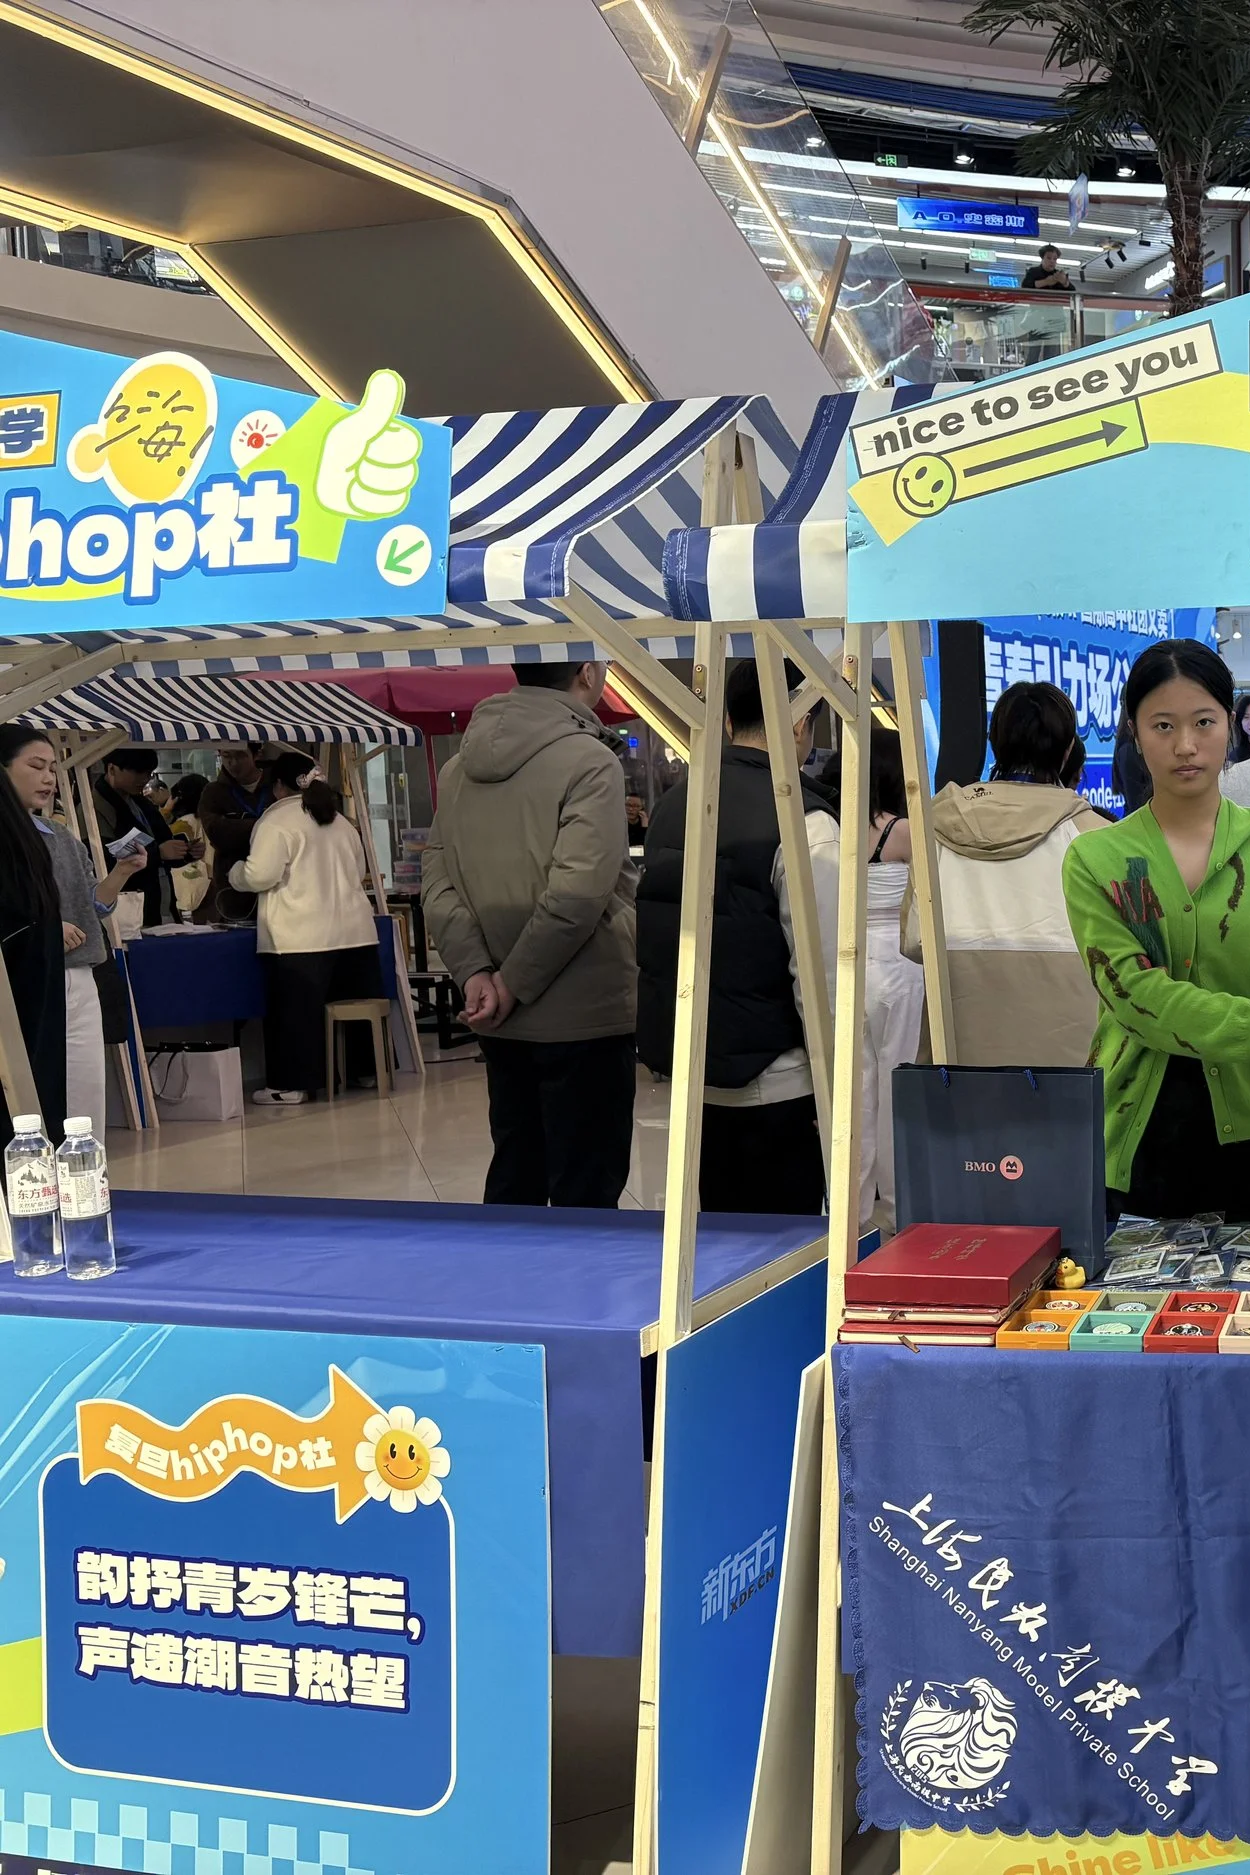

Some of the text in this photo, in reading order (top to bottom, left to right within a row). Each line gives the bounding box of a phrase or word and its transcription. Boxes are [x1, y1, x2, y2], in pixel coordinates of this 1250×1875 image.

[873, 341, 1199, 457] nice to see you
[0, 479, 293, 598] hop社
[964, 1160, 996, 1173] BMO
[104, 1420, 337, 1481] 复旦hiphop社
[701, 1525, 778, 1626] 新东方
[730, 1569, 775, 1616] XDF.CN
[77, 1626, 406, 1709] 声递潮音热望
[868, 1516, 1176, 1821] Shanghai Nanyang Model Private School
[910, 1764, 929, 1784] 2015
